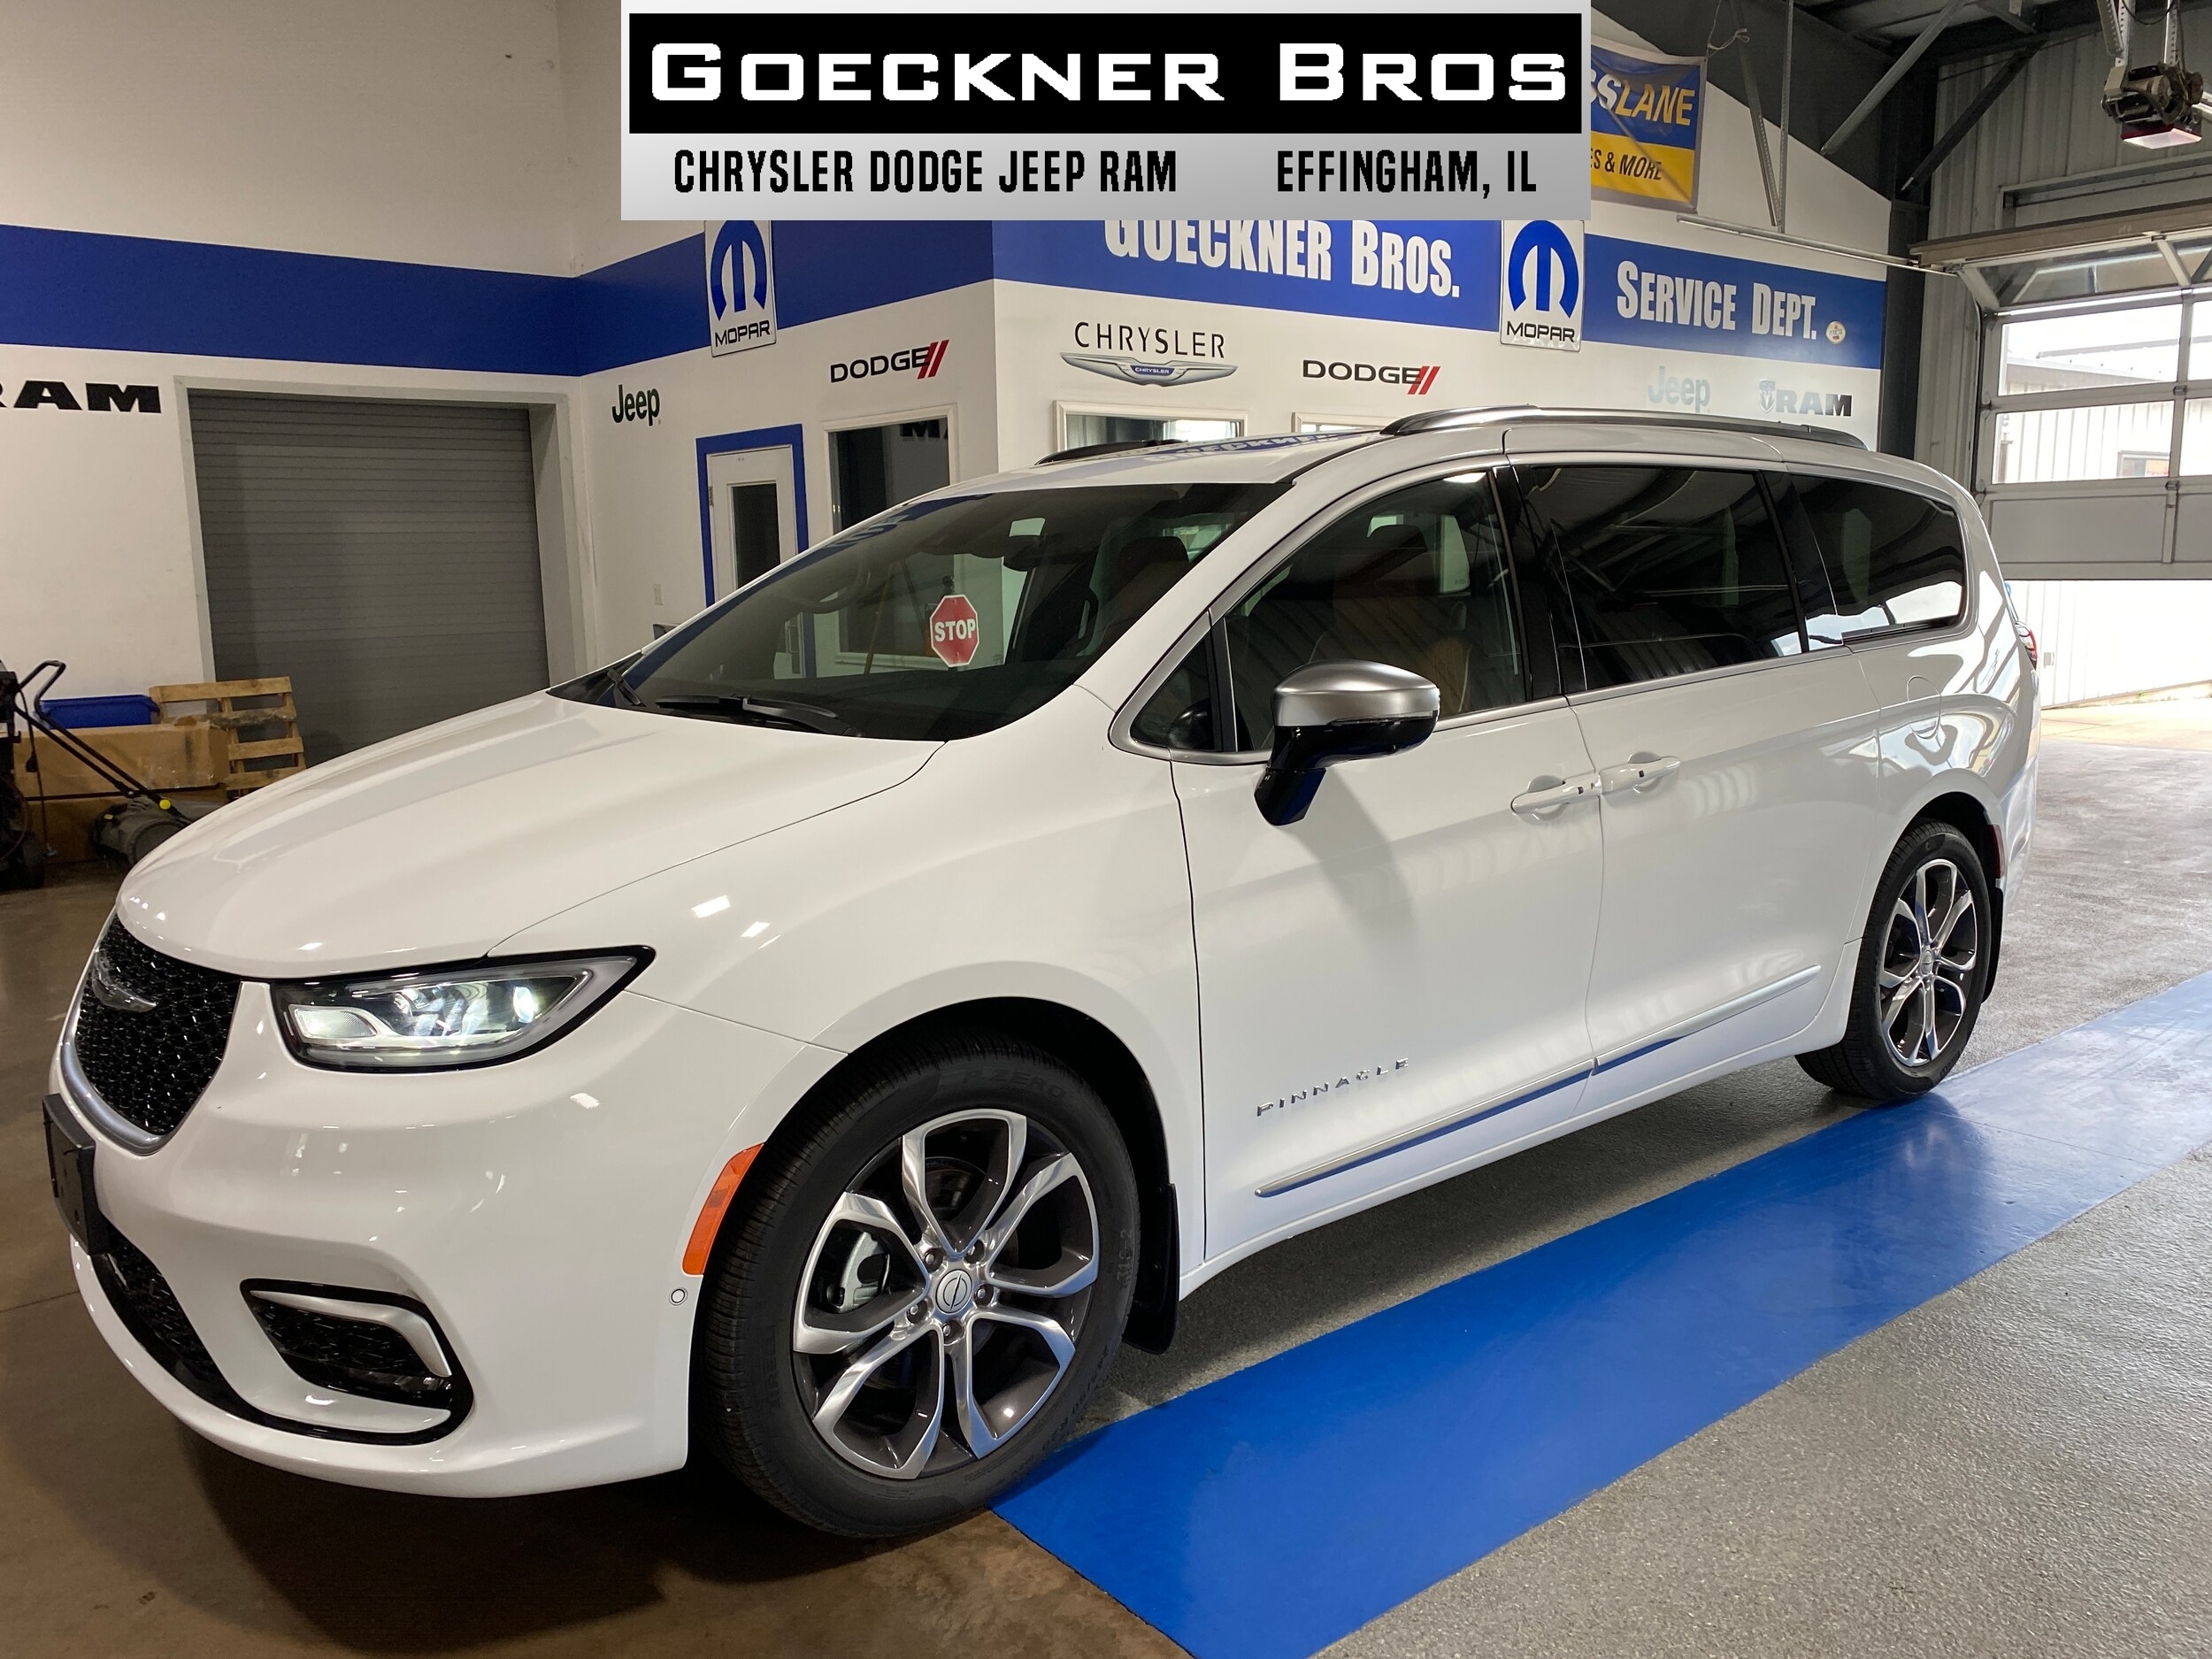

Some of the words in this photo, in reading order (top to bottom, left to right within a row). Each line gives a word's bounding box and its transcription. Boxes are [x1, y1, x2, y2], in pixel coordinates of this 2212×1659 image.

[1604, 152, 1616, 174] &
[1618, 154, 1662, 180] MORE
[1350, 220, 1461, 297] BROS.
[1616, 259, 1736, 331] SERVICE
[1751, 281, 1817, 340] DEPT.
[715, 320, 771, 346] MOPAR
[1074, 321, 1225, 358] CHRYSLER
[1507, 320, 1575, 342] MOPAR
[830, 346, 932, 382] DODGE
[1134, 366, 1170, 375] CHRYSLER
[1302, 359, 1423, 386] DODGE
[611, 383, 660, 426] Jeep
[1647, 365, 1709, 412] Jeep
[1775, 389, 1853, 418] RAM
[934, 618, 976, 642] STOP
[1256, 1057, 1409, 1117] PINNACLE
